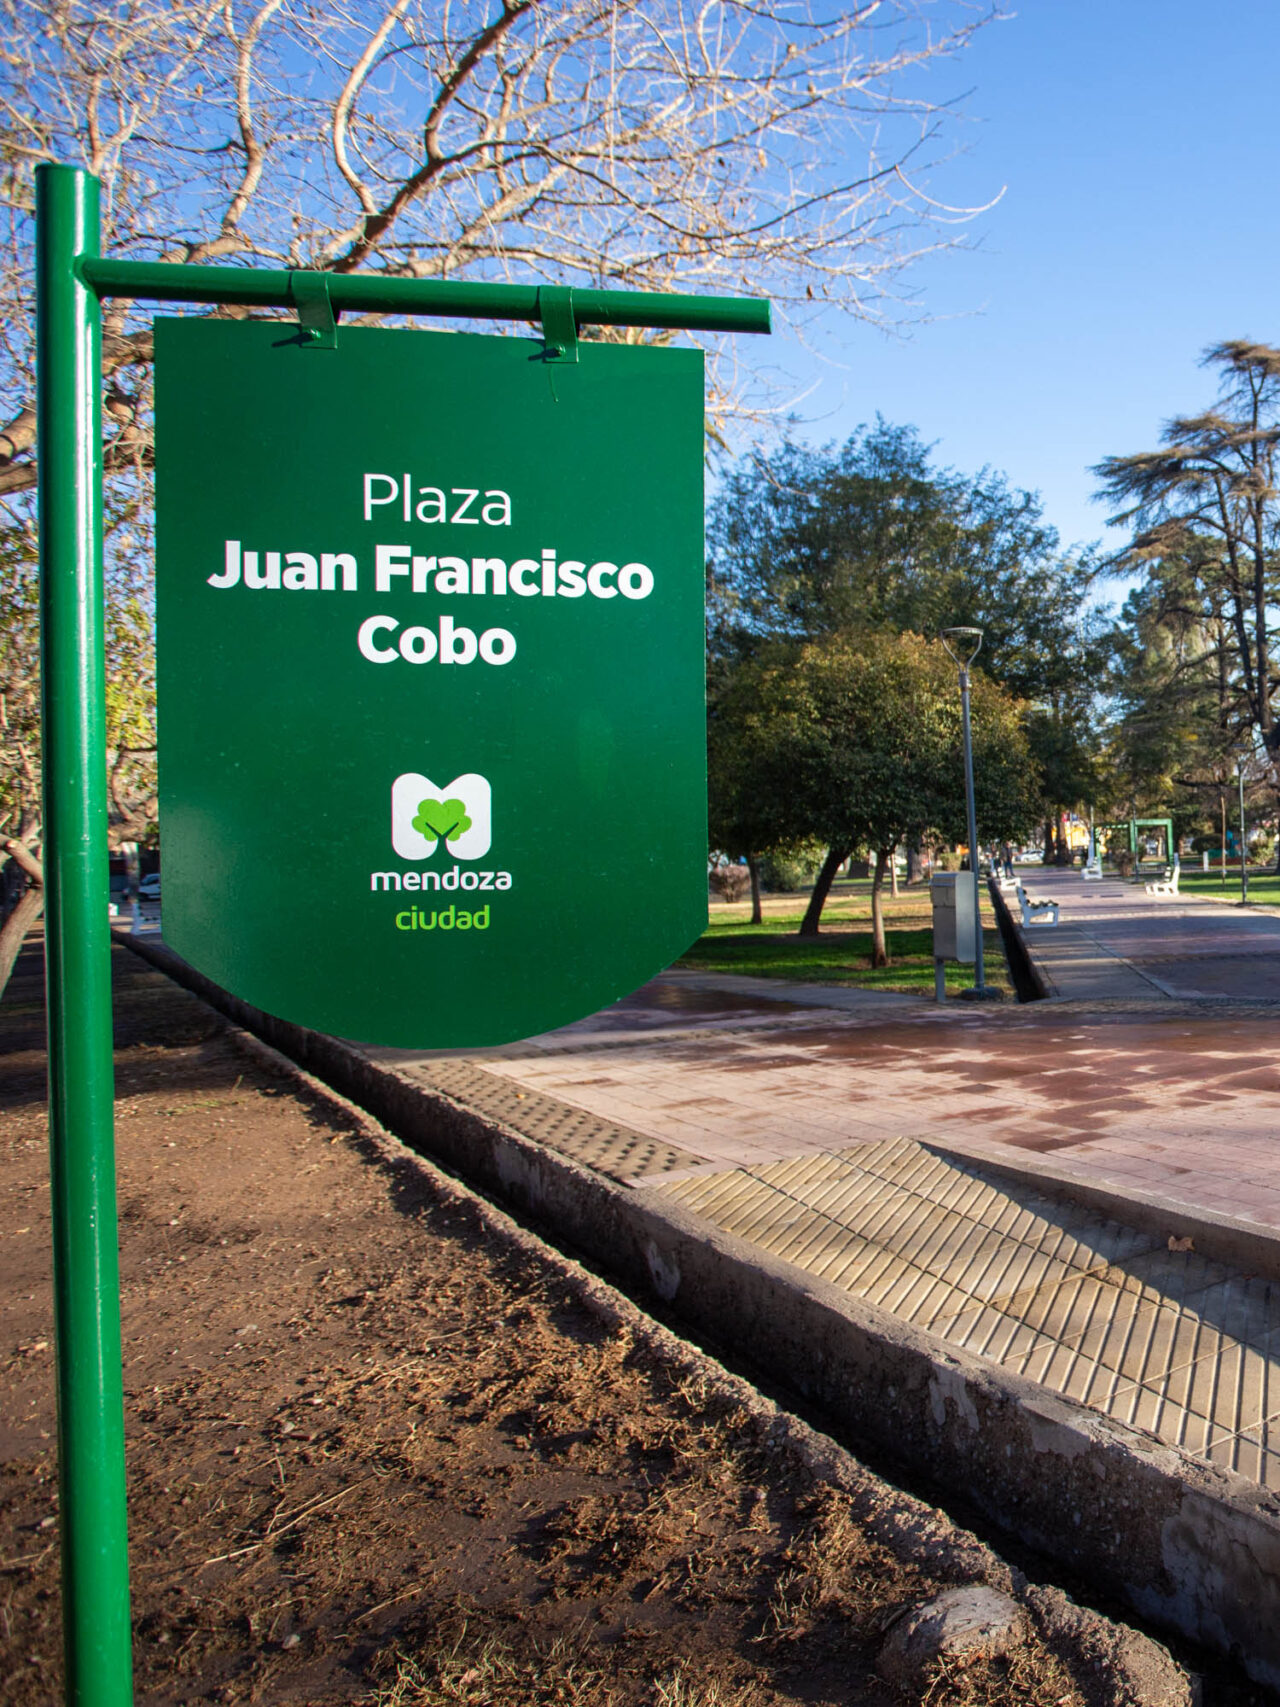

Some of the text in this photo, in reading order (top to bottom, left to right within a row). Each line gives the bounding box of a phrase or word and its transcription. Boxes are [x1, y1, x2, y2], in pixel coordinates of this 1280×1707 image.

[362, 472, 512, 526] Plaza
[206, 540, 655, 600] Juan Francisco
[357, 614, 518, 666] Cobo
[370, 864, 513, 892] mendoza
[395, 904, 491, 931] ciudad
